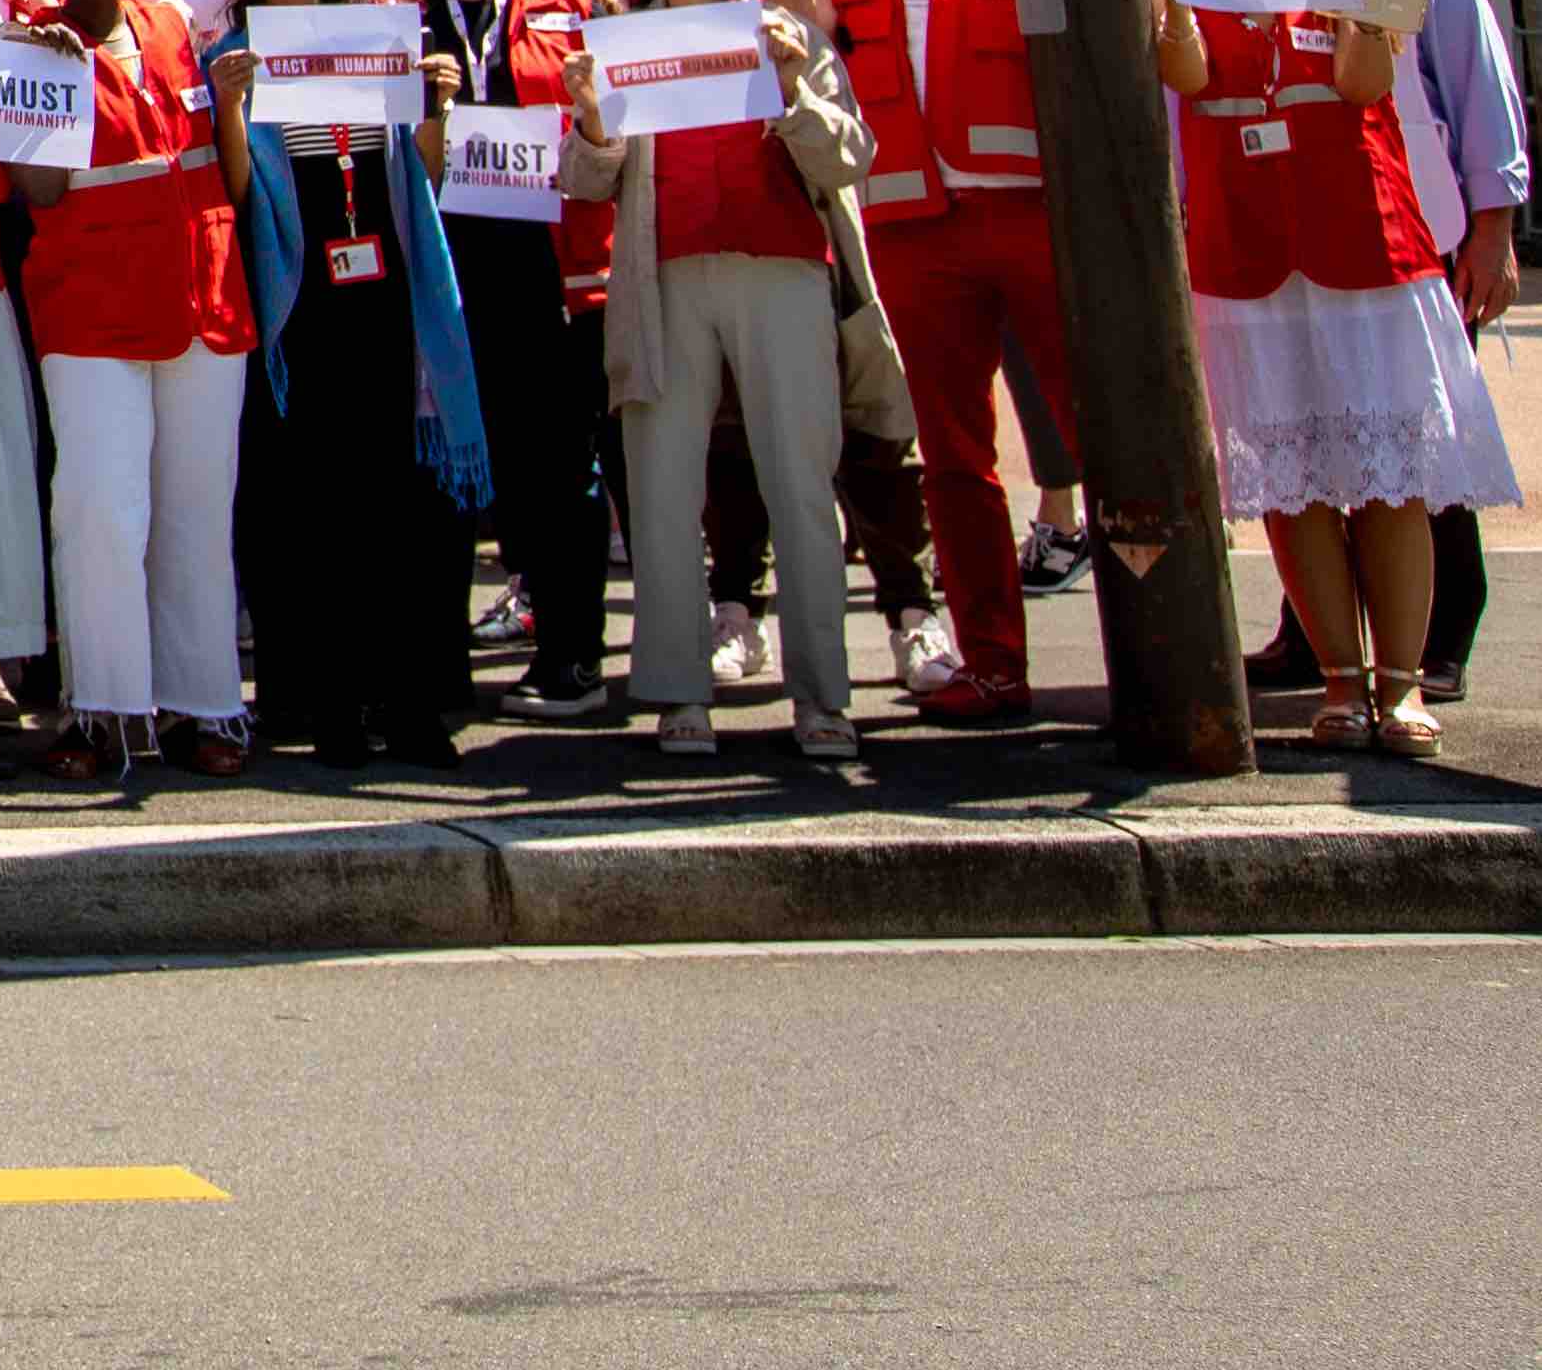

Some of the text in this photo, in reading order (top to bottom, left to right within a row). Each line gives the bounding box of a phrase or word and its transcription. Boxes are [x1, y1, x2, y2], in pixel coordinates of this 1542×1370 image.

[272, 55, 404, 75] #ACTFORHUMANITY
[465, 142, 547, 173] MUST
[446, 171, 545, 190] FORHUMANITY
